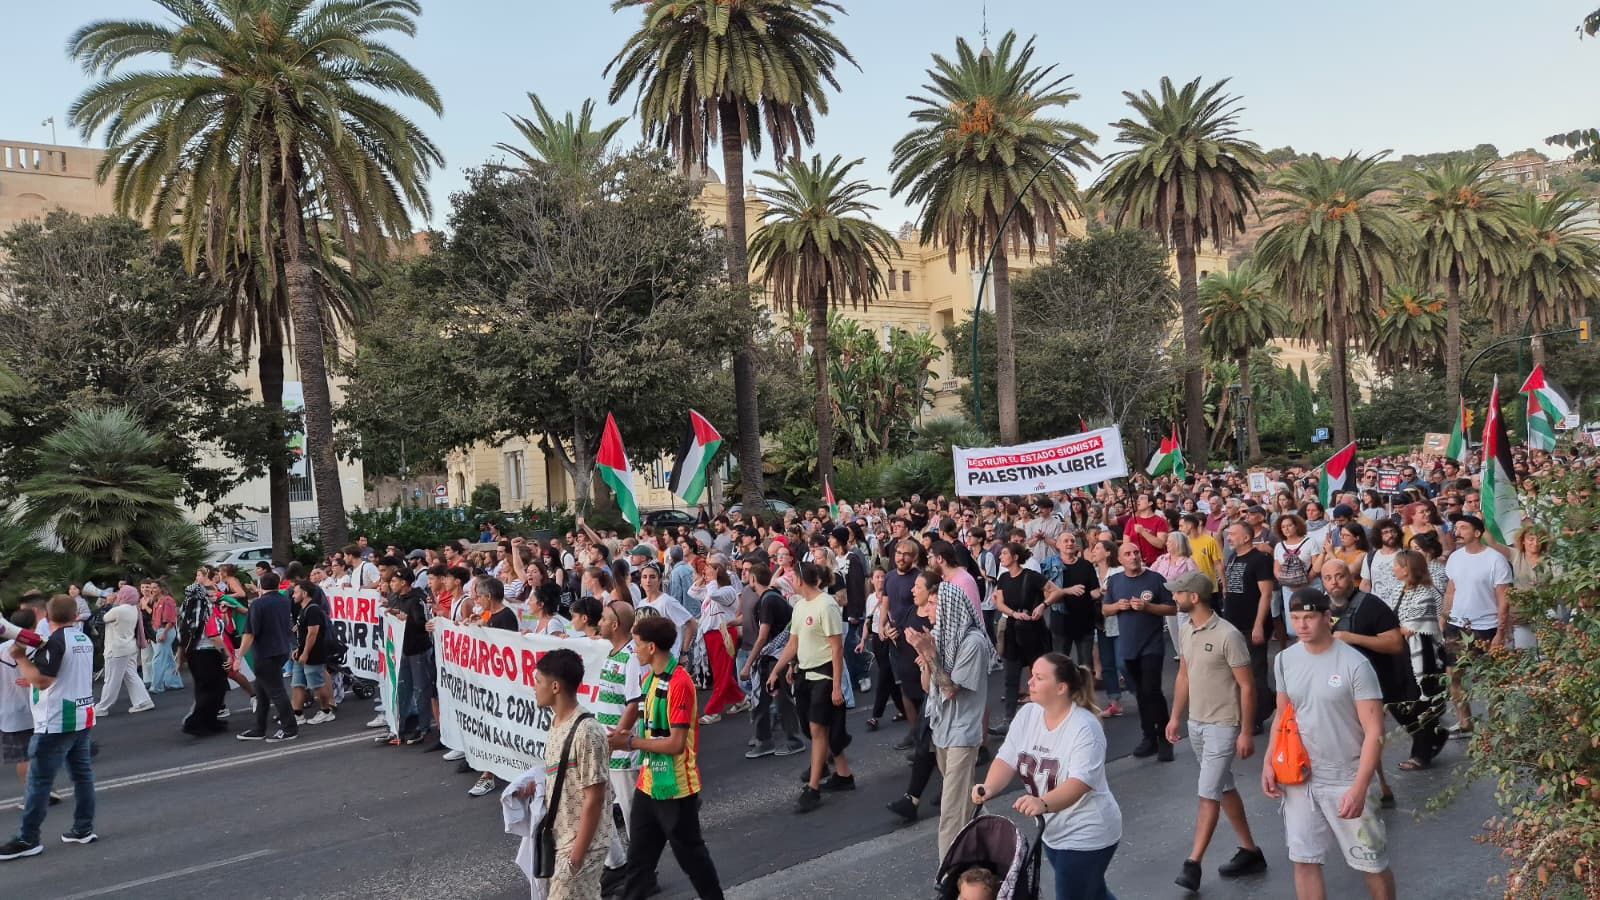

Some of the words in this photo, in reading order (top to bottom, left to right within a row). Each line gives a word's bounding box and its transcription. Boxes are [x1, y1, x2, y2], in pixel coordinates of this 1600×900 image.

[1020, 450, 1056, 463] ESTADO
[1057, 439, 1100, 458] SIONISTA
[968, 464, 1058, 486] PALESTINA
[1059, 453, 1107, 474] LIBRE
[469, 683, 503, 718] TOTAL
[507, 695, 535, 727] CON
